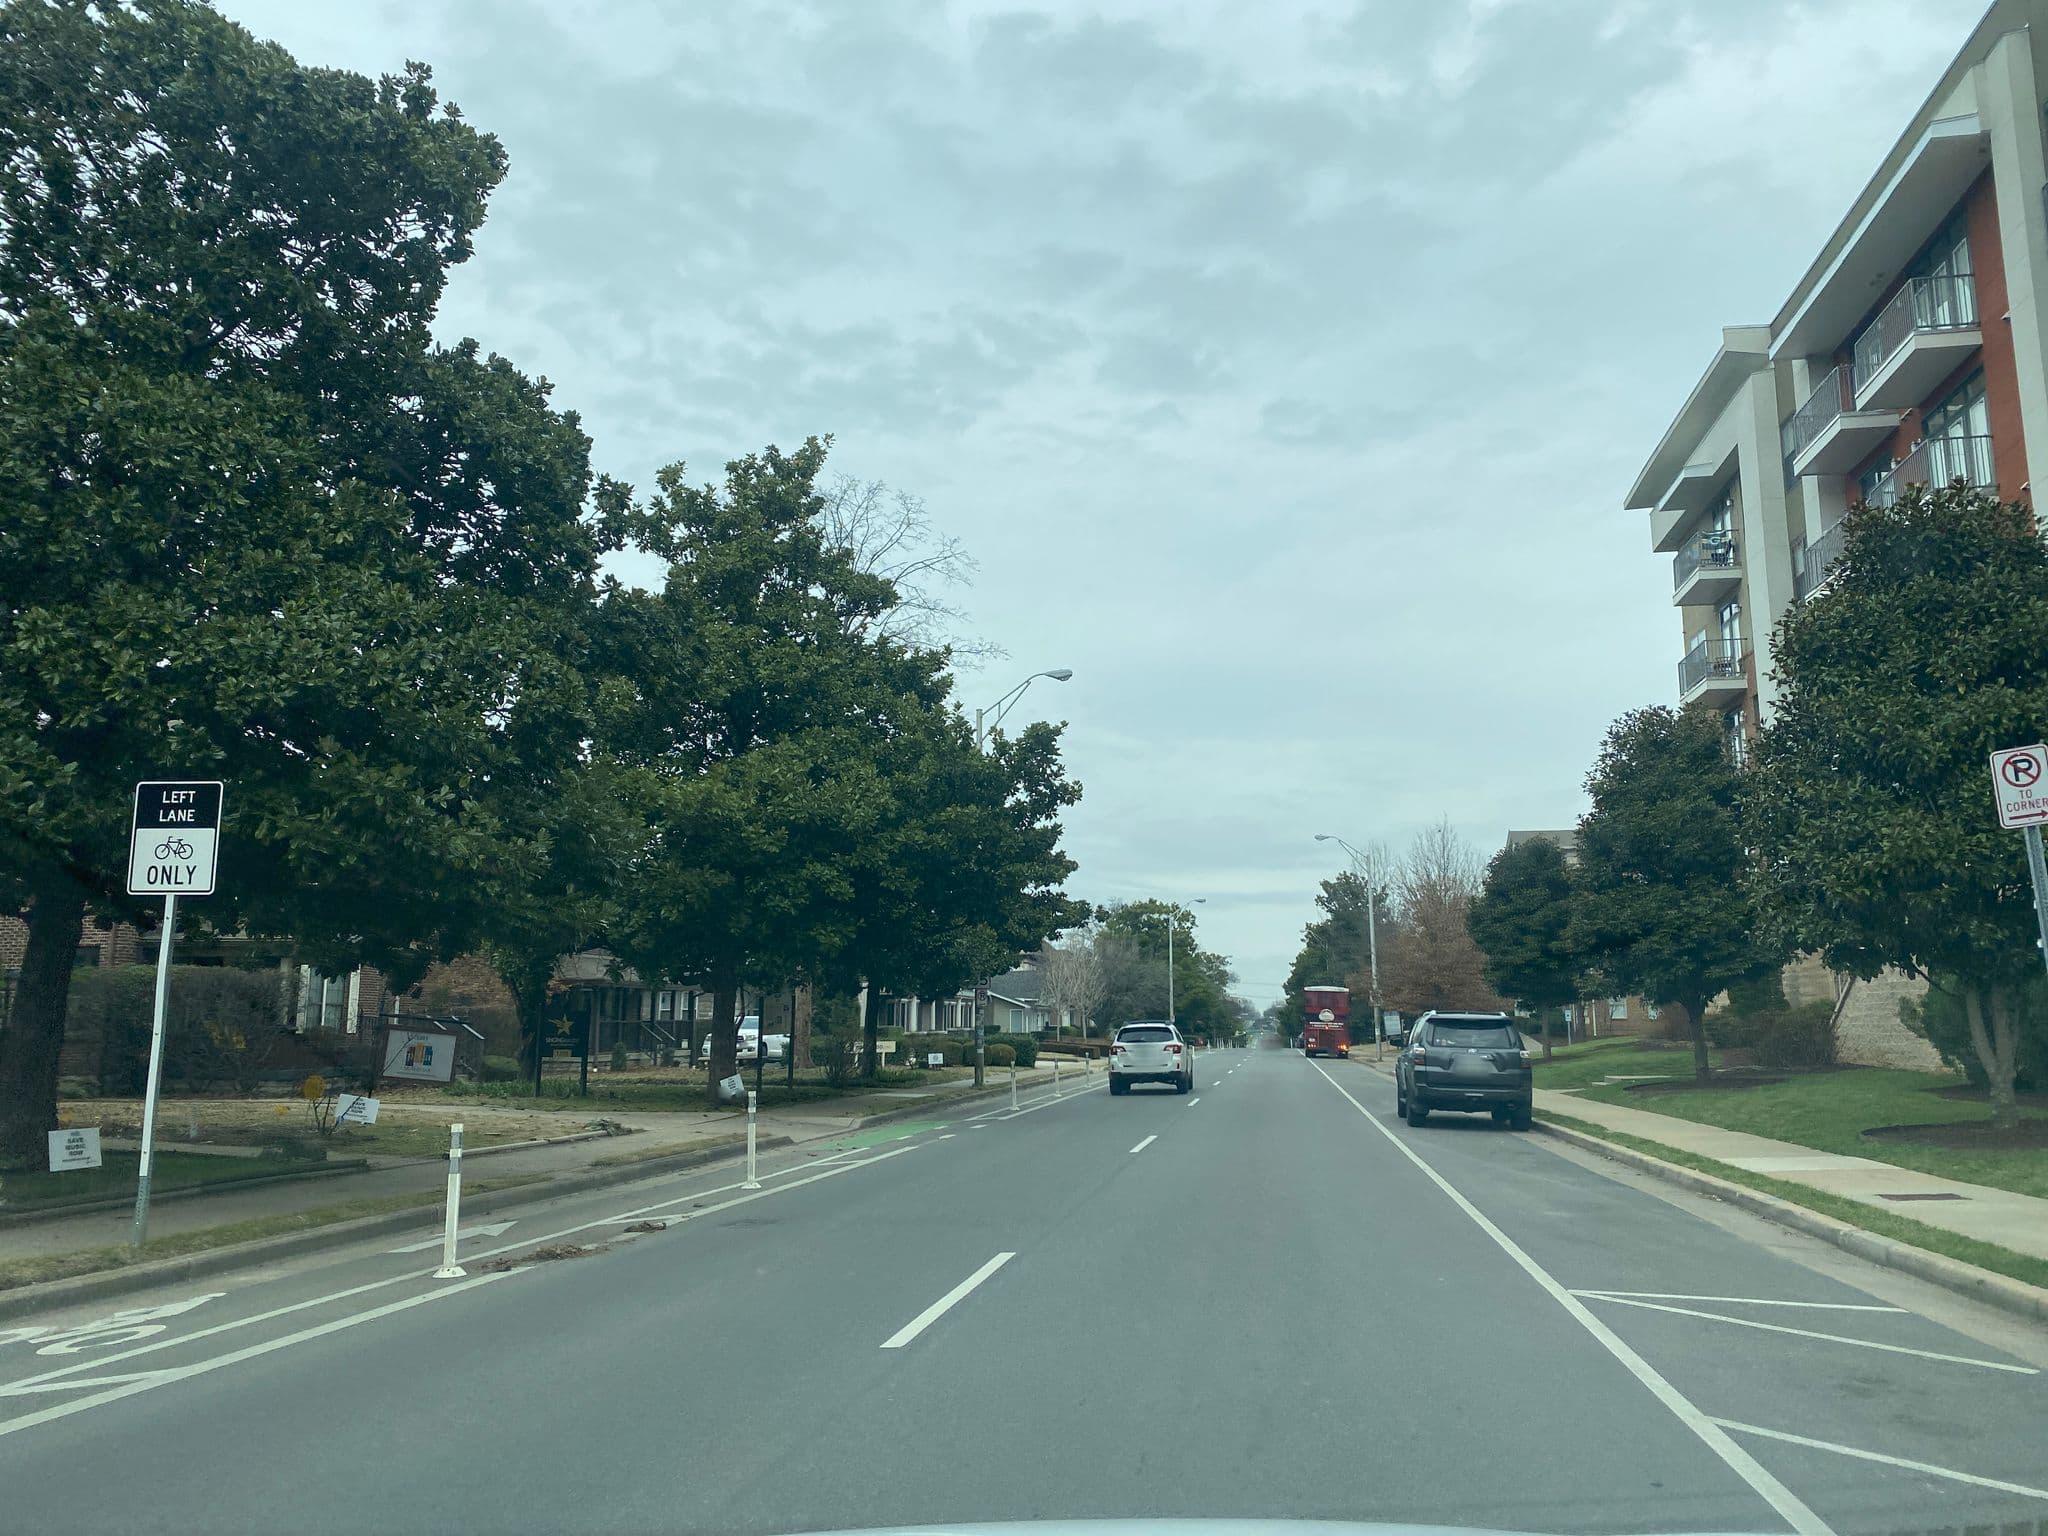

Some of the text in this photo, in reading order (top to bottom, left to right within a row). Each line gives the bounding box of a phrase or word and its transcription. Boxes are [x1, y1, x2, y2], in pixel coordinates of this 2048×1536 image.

[162, 790, 197, 804] LEFT
[2019, 789, 2033, 800] TO
[2006, 797, 2048, 813] CORNER
[159, 809, 197, 822] LANE
[147, 865, 198, 886] ONLY
